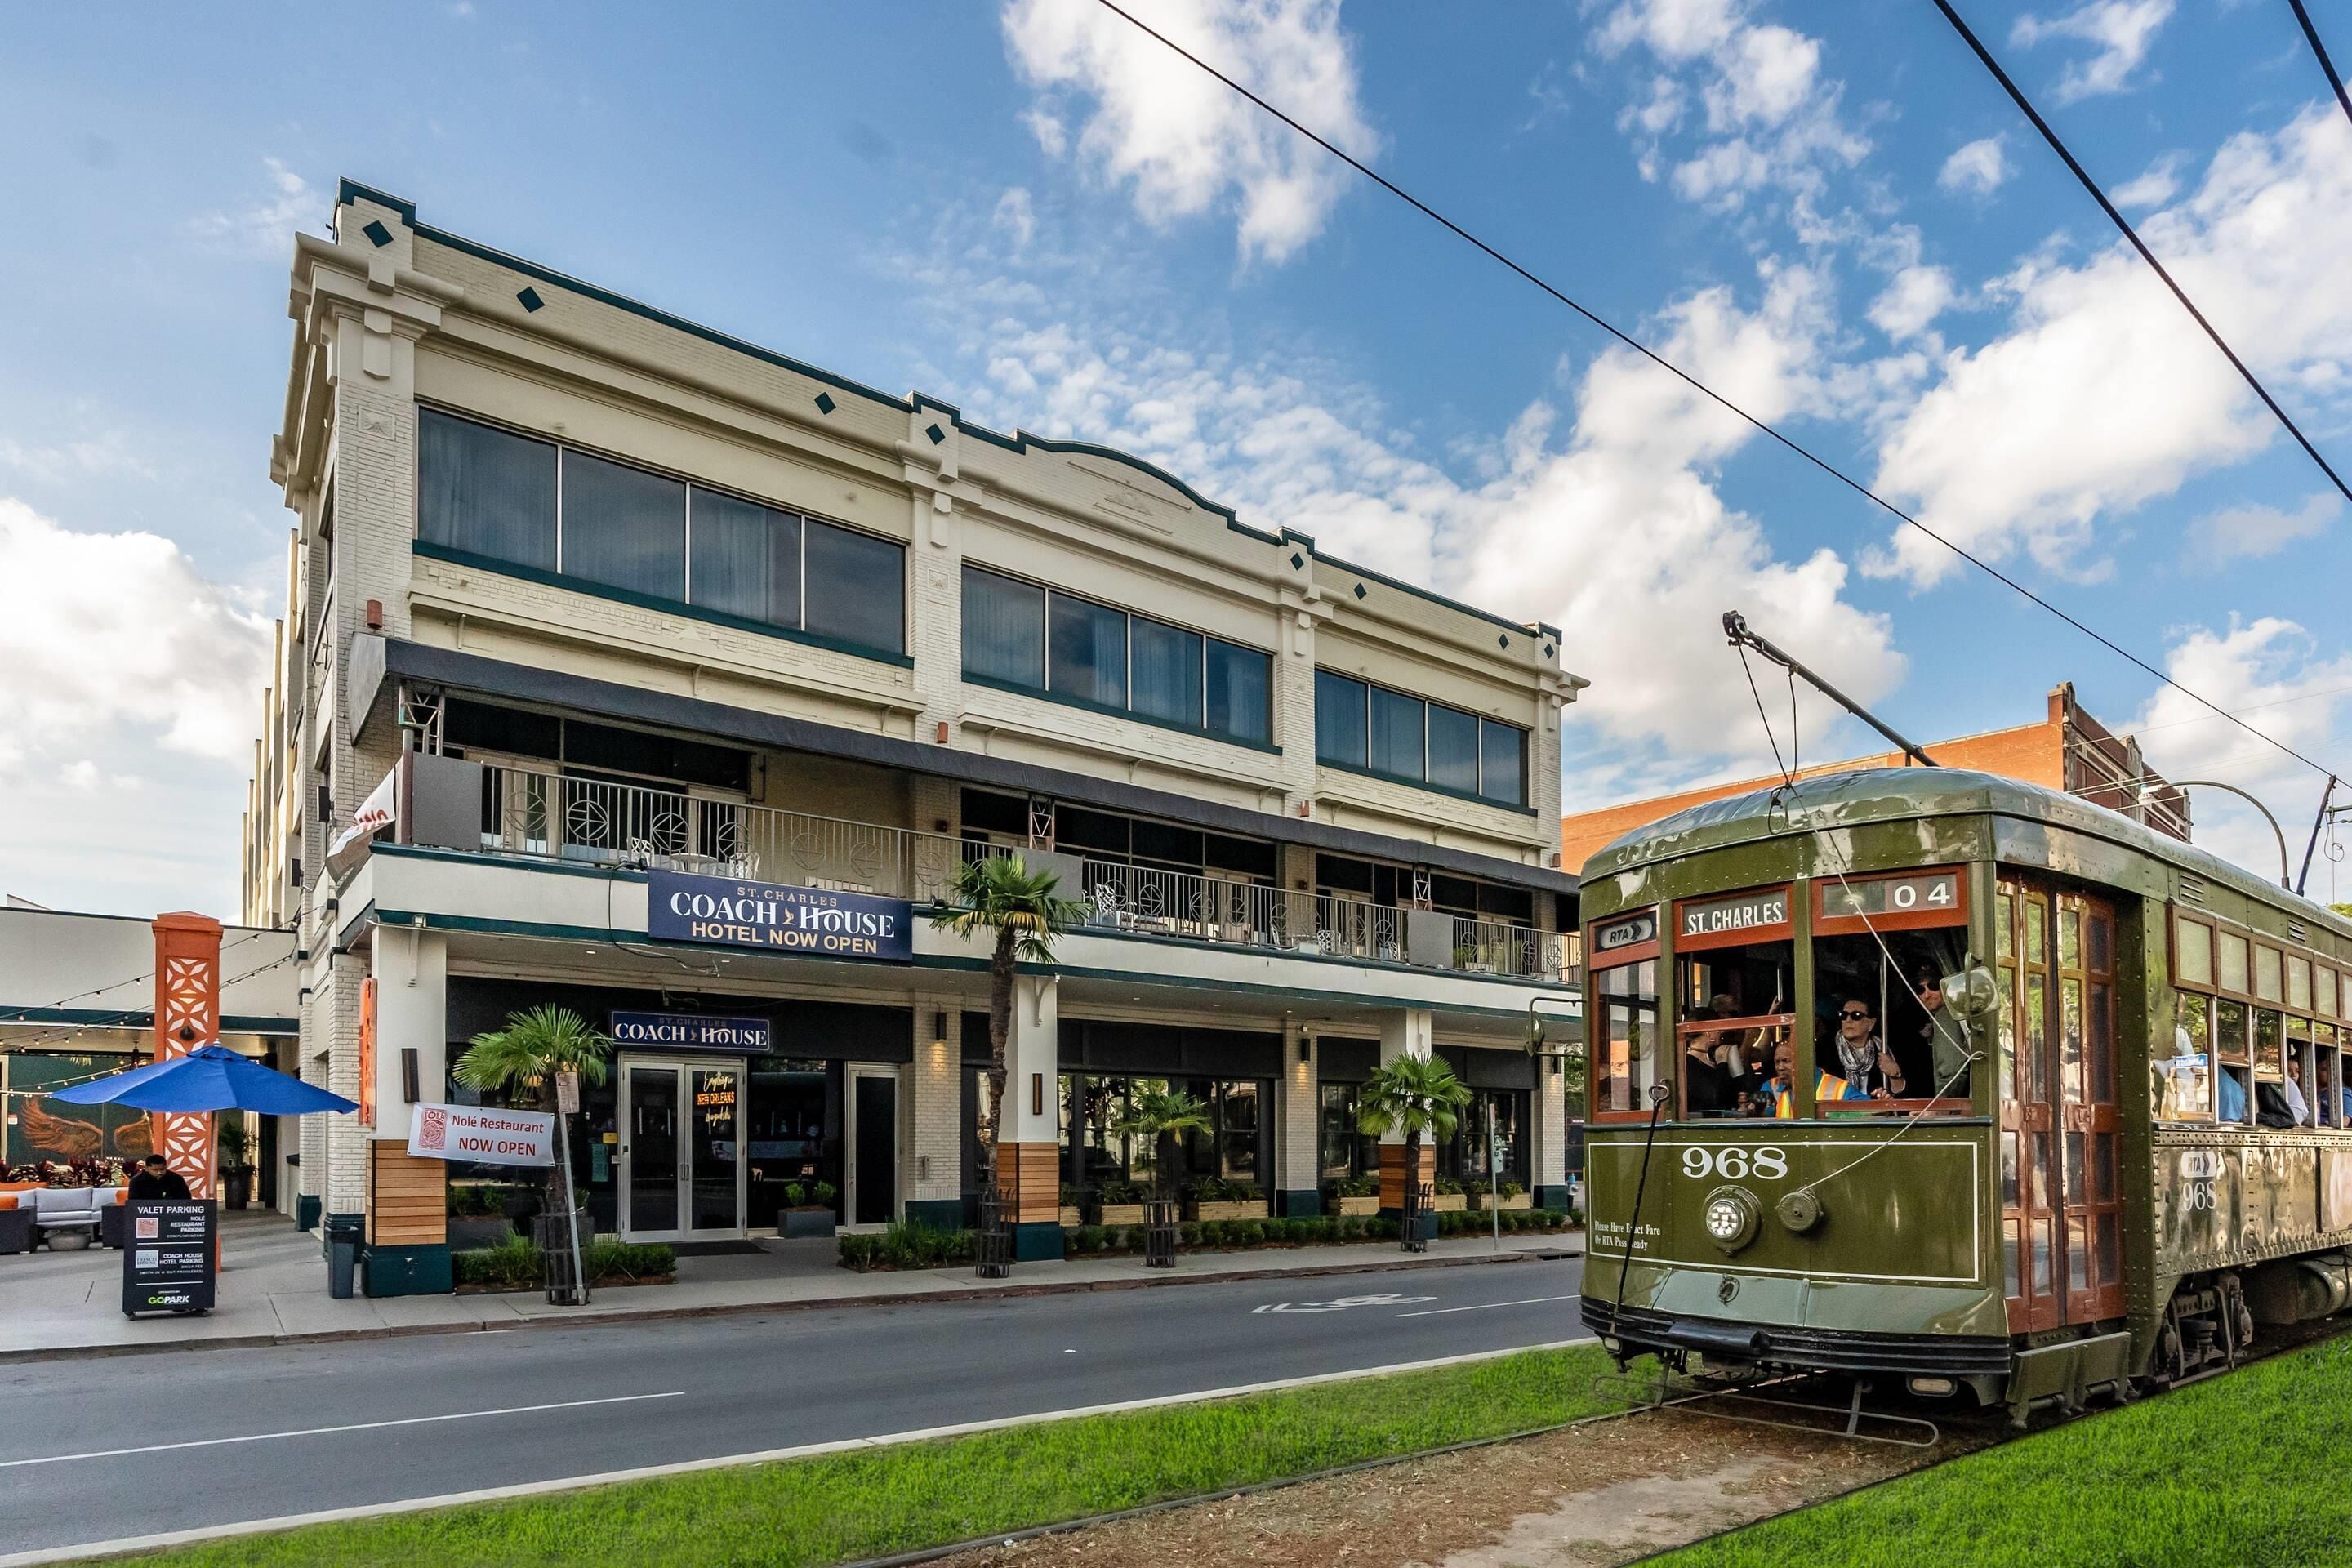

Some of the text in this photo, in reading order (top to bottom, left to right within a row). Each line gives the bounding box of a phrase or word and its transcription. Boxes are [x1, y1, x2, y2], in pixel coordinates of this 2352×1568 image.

[737, 886, 838, 906] ST. CHARLES
[670, 891, 895, 938] COACH HOUSE
[1688, 902, 1783, 933] ST. CHARLES
[692, 920, 877, 954] HOTEL NOW OPEN
[1610, 928, 1628, 943] RTA
[676, 1018, 727, 1027] CHARLES
[614, 1023, 767, 1046] COACH HOUSE
[452, 1115, 545, 1134] Nolé Restaurant
[458, 1137, 536, 1156] NOW OPEN
[1682, 1147, 1788, 1180] 968
[2187, 1156, 2202, 1173] RTA
[2182, 1181, 2216, 1211] 968
[167, 1205, 205, 1214] PARKING
[1594, 1220, 1610, 1232] Please
[1610, 1222, 1624, 1233] Have
[1646, 1223, 1661, 1236] Fare
[1594, 1234, 1648, 1251] Or RTA Pass eady
[148, 1295, 190, 1304] GOPARK
